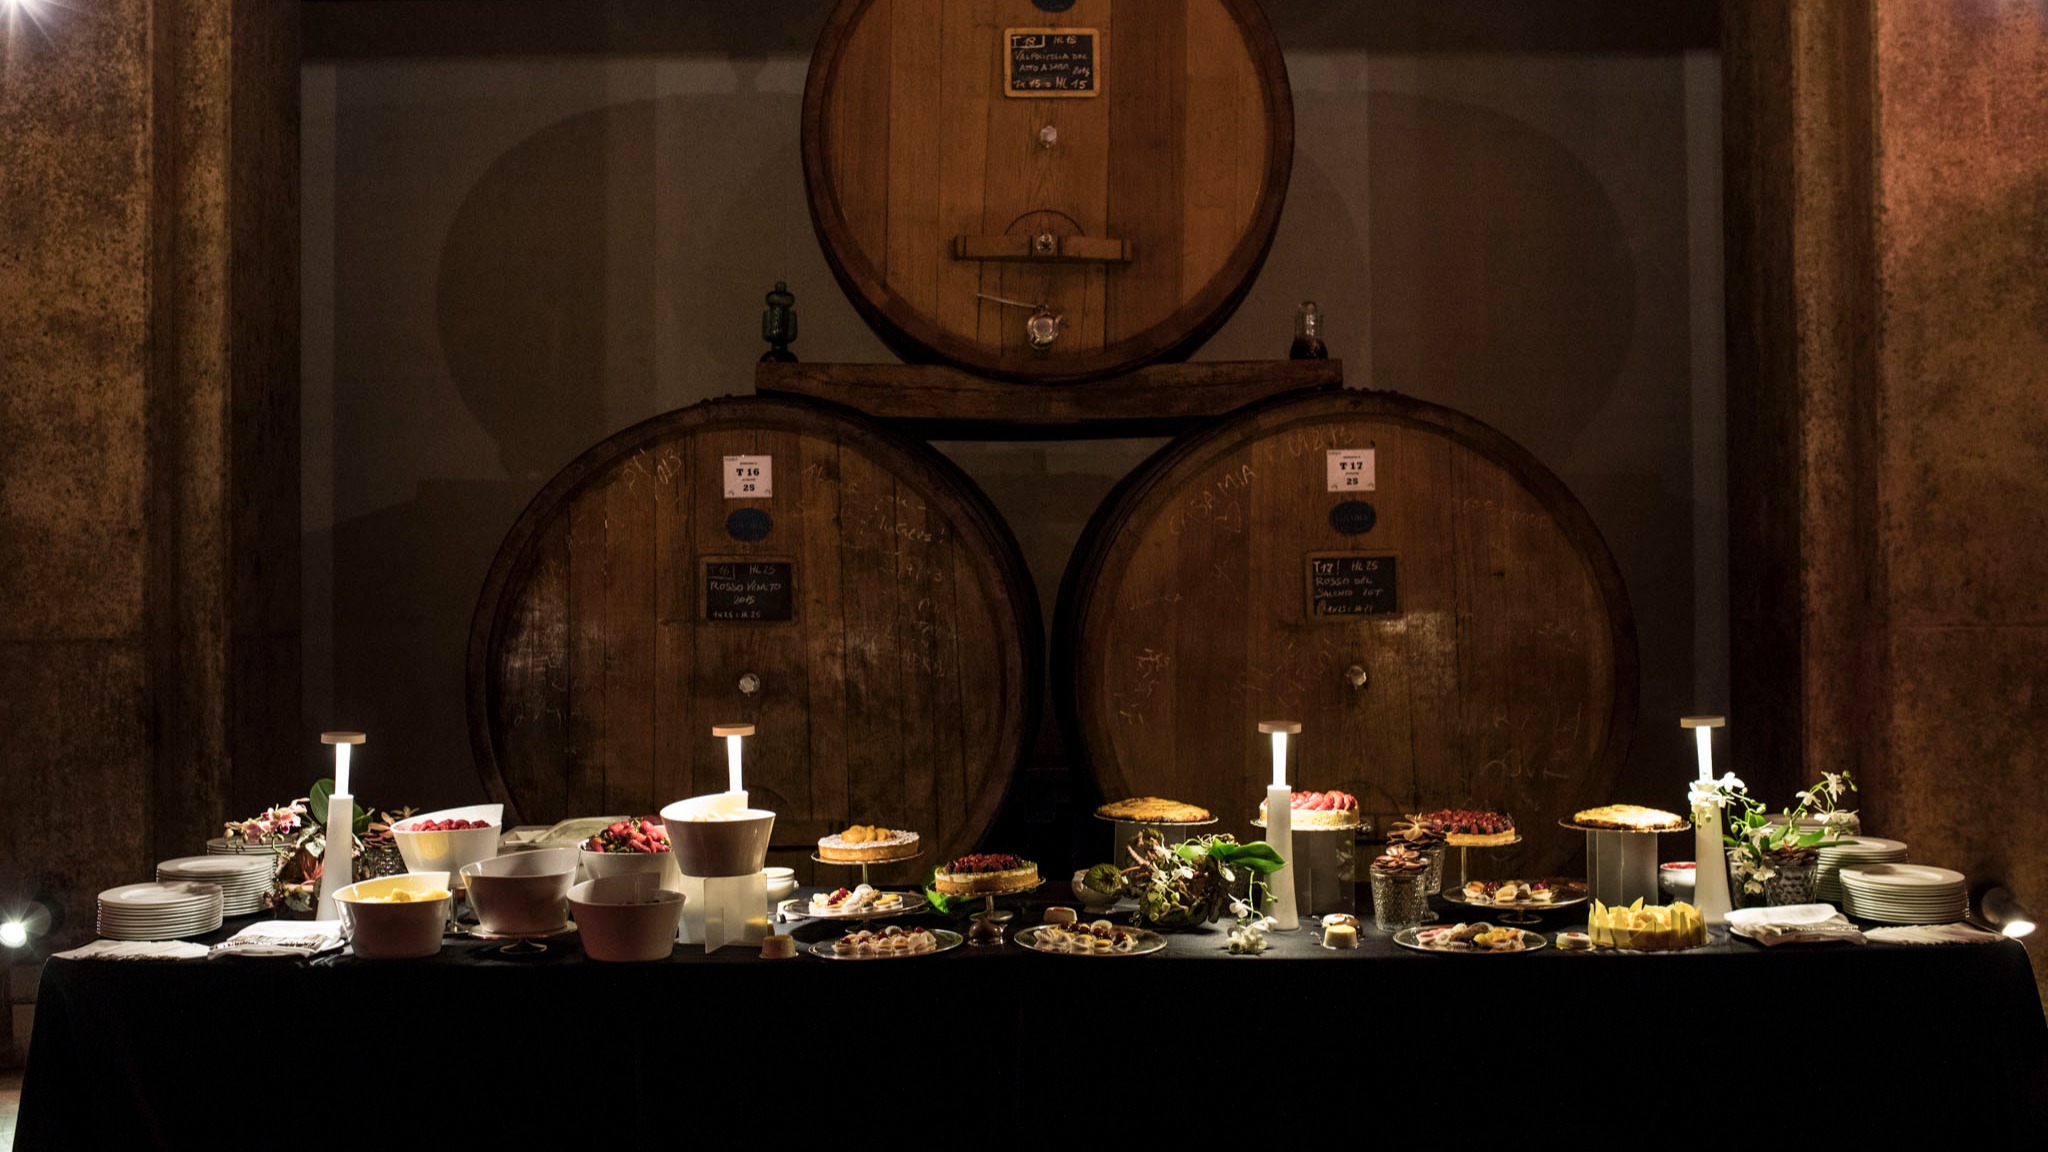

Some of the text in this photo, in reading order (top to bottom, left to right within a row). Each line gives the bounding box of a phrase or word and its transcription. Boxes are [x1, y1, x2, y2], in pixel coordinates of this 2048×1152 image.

[1011, 35, 1022, 46] T
[1070, 78, 1088, 90] 15
[1339, 461, 1363, 470] T 17
[736, 467, 760, 476] T 16
[1346, 477, 1358, 486] 25
[743, 483, 755, 492] 25
[710, 580, 744, 592] ROSSO
[1315, 576, 1350, 587] ROSSO
